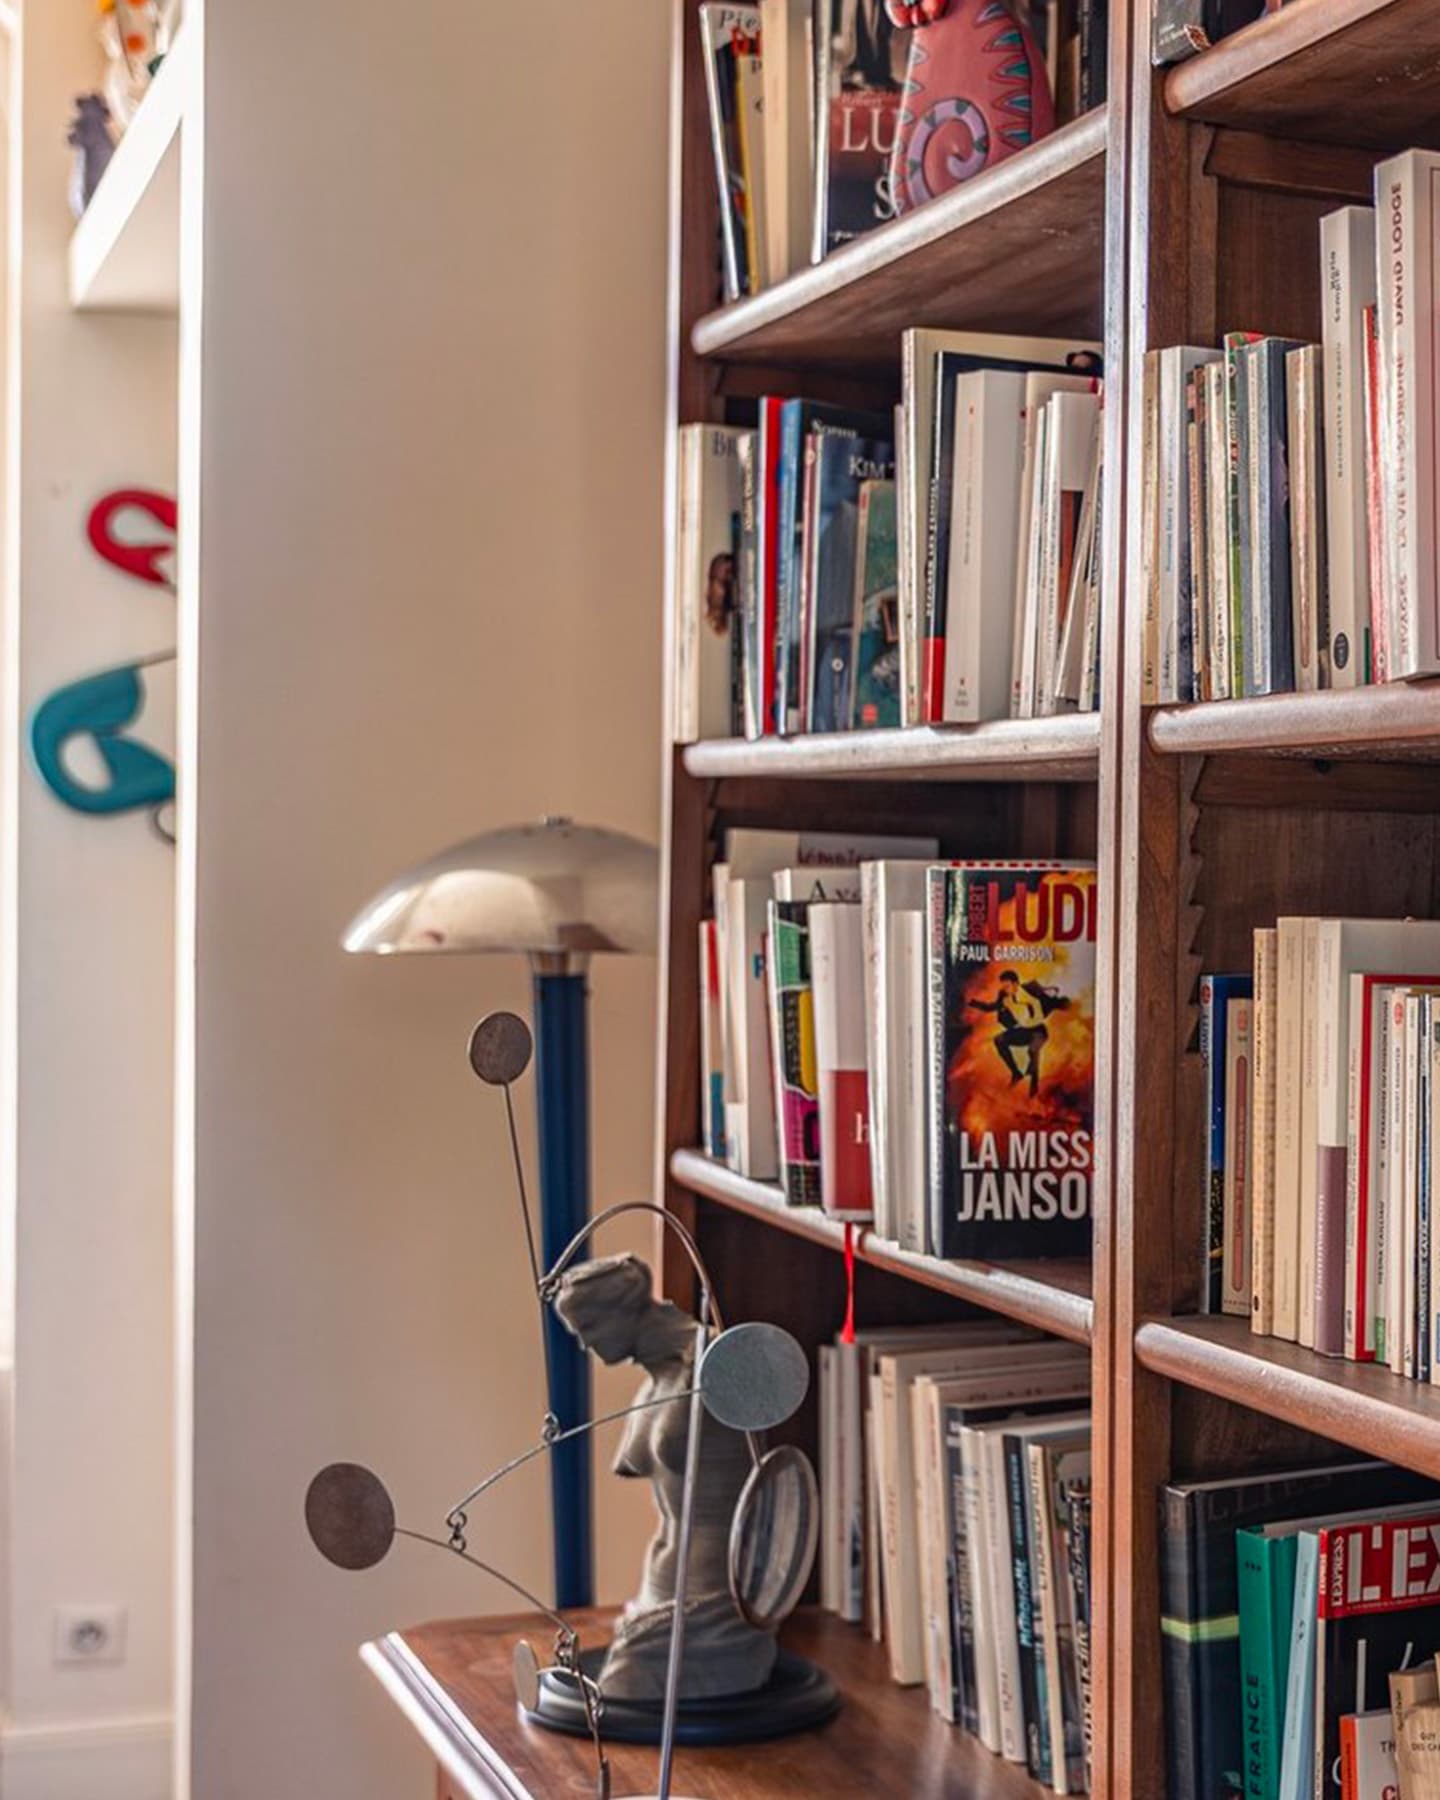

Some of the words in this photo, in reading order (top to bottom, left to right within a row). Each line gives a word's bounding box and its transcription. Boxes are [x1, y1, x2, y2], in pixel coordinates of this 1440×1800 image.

[1391, 182, 1403, 254] LODGE
[1394, 260, 1404, 326] DAVID
[960, 945, 990, 961] PAUL
[994, 946, 1057, 963] GARRISON
[960, 1131, 999, 1169] LA
[1314, 1194, 1325, 1302] Flammarion
[1331, 1535, 1345, 1607] L'EXPRESS
[1245, 1671, 1263, 1797] FRANCE
[1420, 1731, 1438, 1742] GUY
